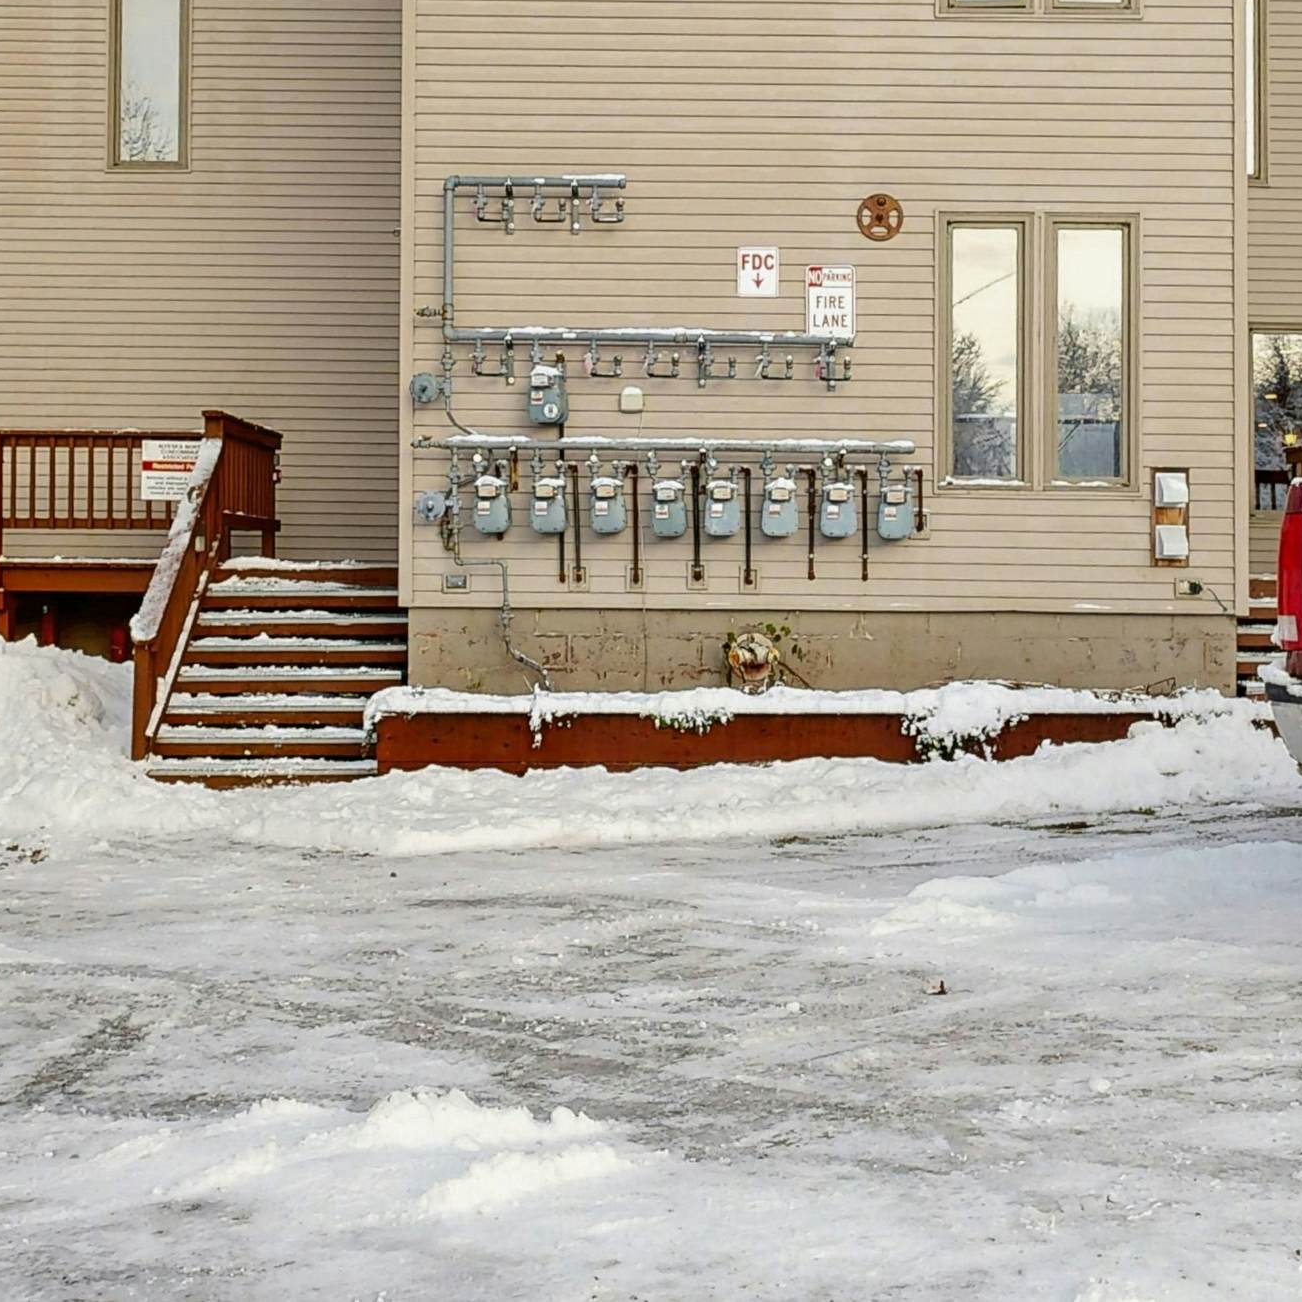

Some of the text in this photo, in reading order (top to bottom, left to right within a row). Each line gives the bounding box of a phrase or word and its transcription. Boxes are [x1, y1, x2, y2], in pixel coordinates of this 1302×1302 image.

[741, 253, 775, 271] FDC
[808, 269, 852, 285] NO PARKING
[816, 295, 845, 310] FIRE
[813, 314, 848, 328] LANE
